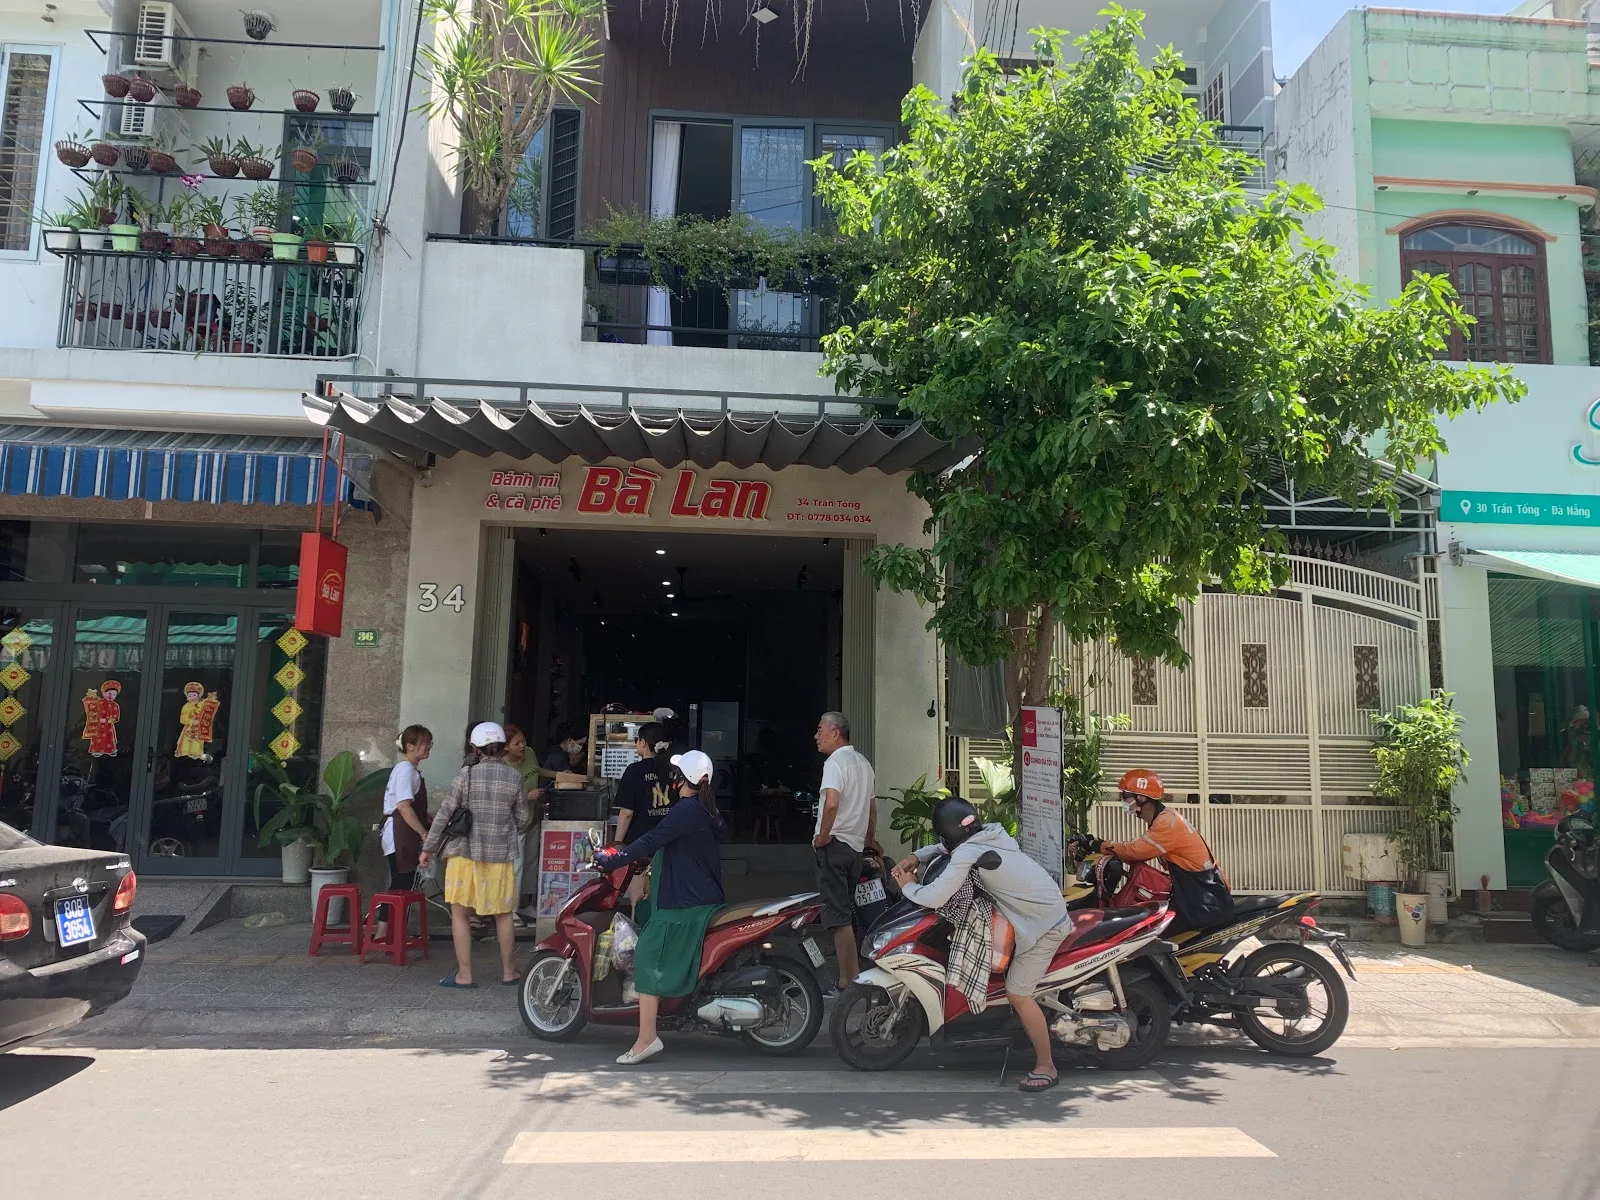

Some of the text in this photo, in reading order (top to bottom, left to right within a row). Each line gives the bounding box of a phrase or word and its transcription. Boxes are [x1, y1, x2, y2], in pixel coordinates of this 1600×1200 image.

[491, 471, 534, 487] Bánh
[576, 466, 771, 521] Bà Lan
[485, 493, 562, 512] & cà phê
[796, 498, 810, 507] 34
[1476, 502, 1488, 513] 30
[807, 513, 831, 522] 0778
[833, 514, 852, 523] 034
[854, 515, 872, 524] 034
[418, 583, 466, 613] 34
[357, 631, 374, 642] 36
[64, 898, 84, 919] 80B
[64, 917, 90, 940] 3654
